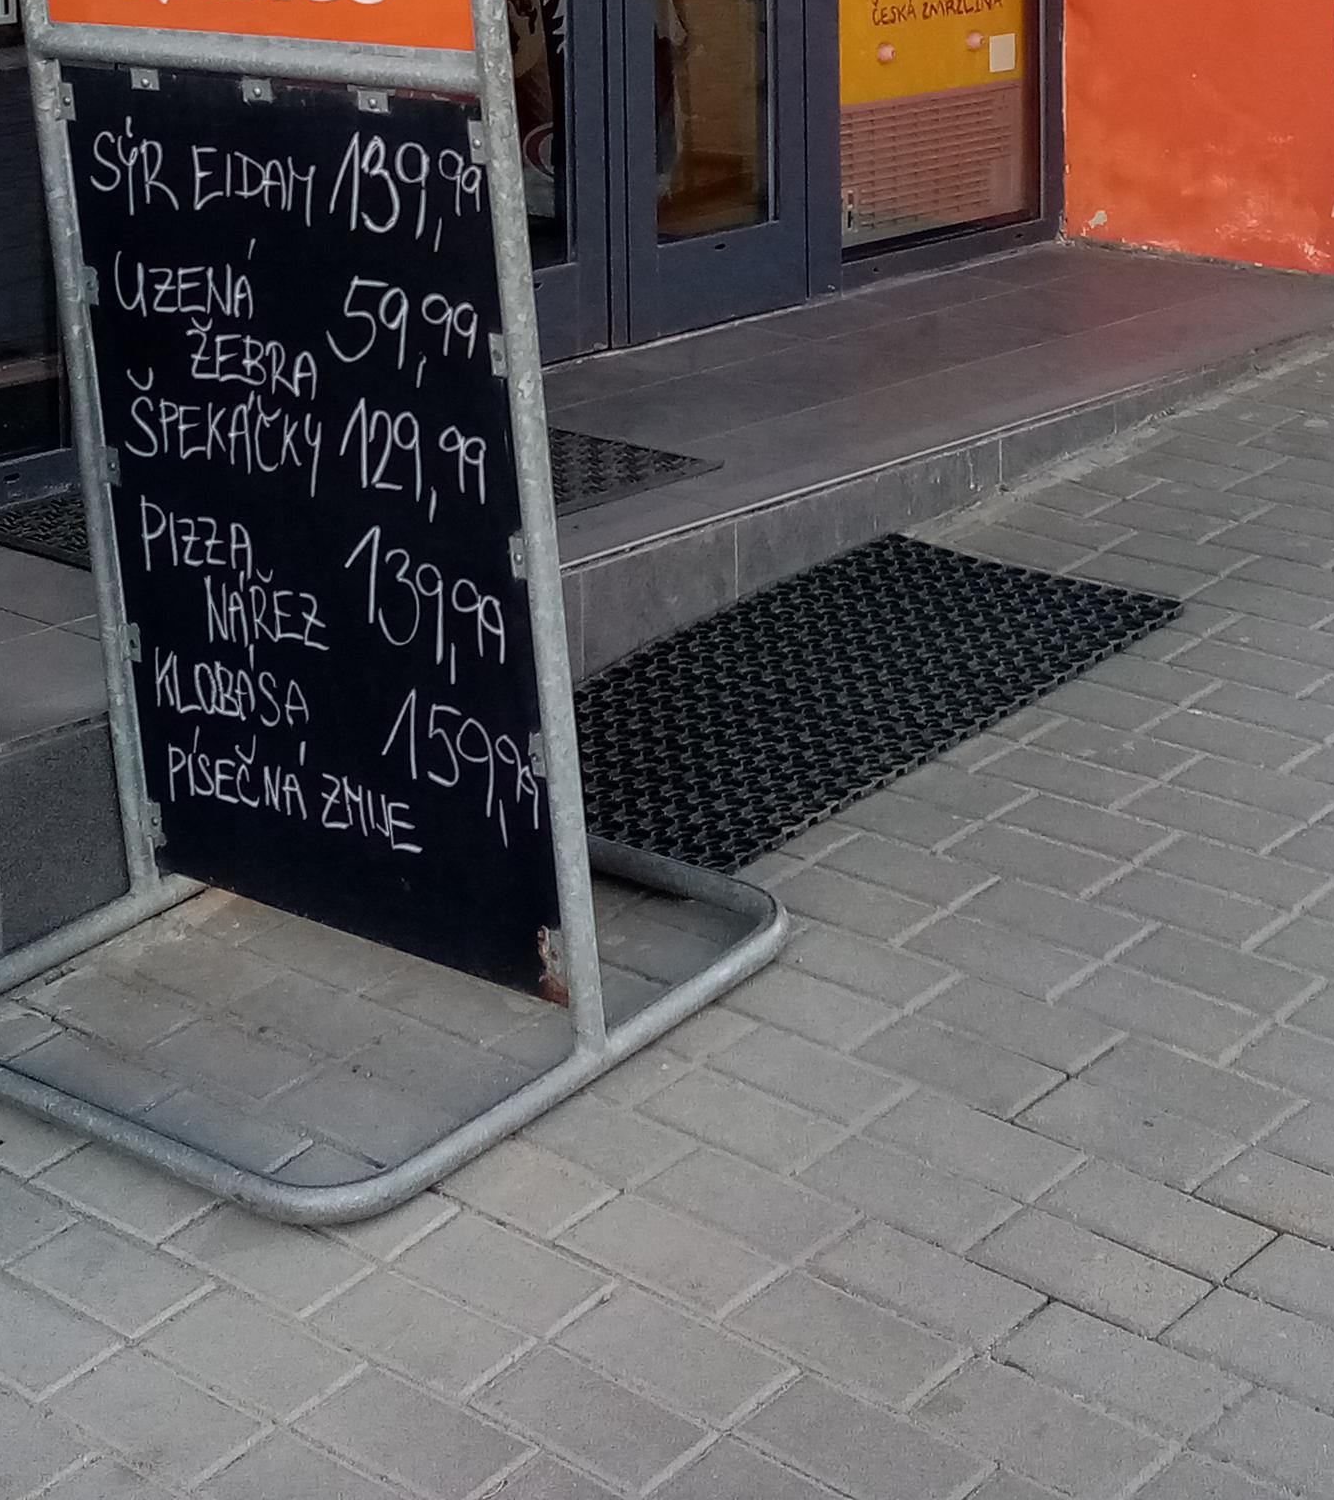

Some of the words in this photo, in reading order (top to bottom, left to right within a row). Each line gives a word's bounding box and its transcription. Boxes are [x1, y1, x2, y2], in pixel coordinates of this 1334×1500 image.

[90, 115, 179, 216] SÝR
[192, 145, 316, 227] EIDAM
[114, 238, 257, 319] UZENÁ
[186, 317, 318, 401] ŽEBRA
[124, 367, 322, 498] ŠPEKÁČKY
[140, 495, 254, 579] PIZZA
[204, 568, 330, 651] NÁŘEZ
[154, 644, 309, 728] KLOBÁSA
[167, 726, 308, 821] PÍSEČNÁ
[321, 772, 423, 854] ZMIJE
